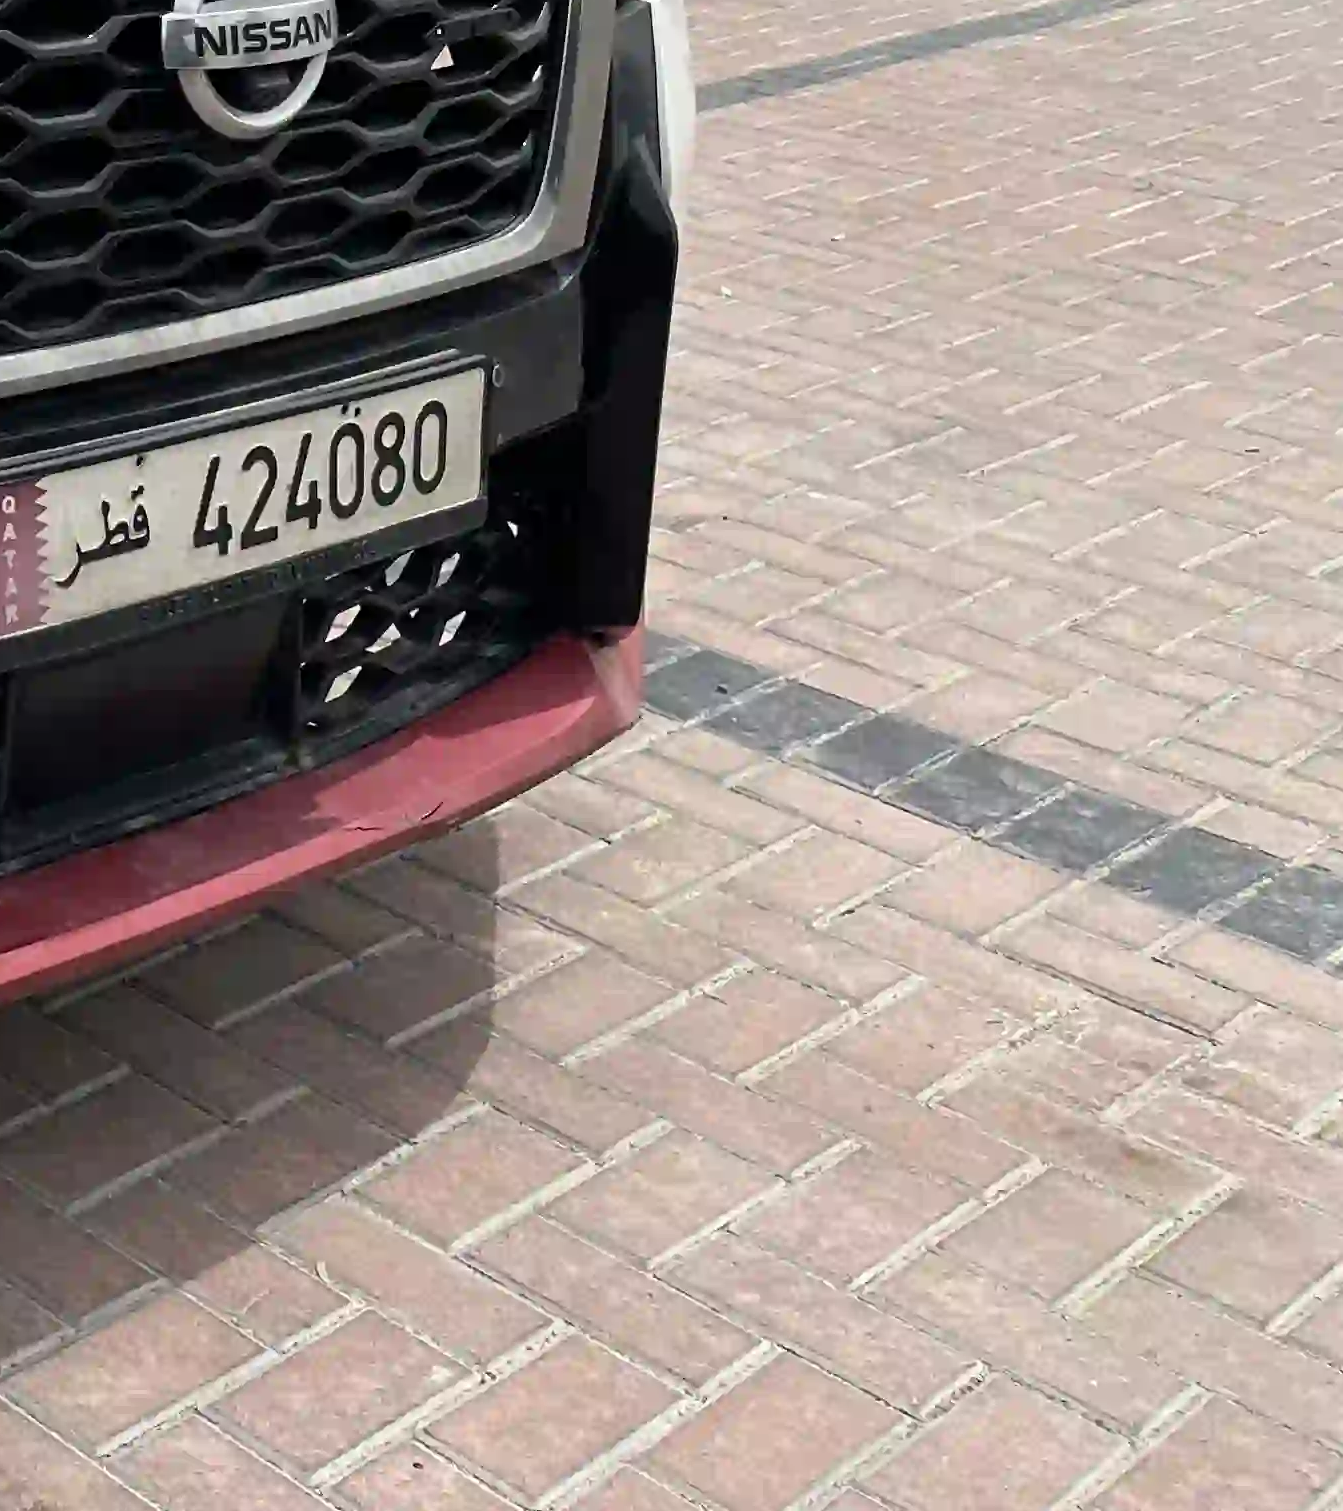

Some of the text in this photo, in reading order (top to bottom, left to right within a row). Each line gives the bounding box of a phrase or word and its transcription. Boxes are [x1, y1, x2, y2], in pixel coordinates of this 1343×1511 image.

[193, 8, 332, 59] NISSAN
[51, 486, 151, 589] قطر
[191, 399, 448, 556] 424080
[1, 495, 19, 627] QATAR
